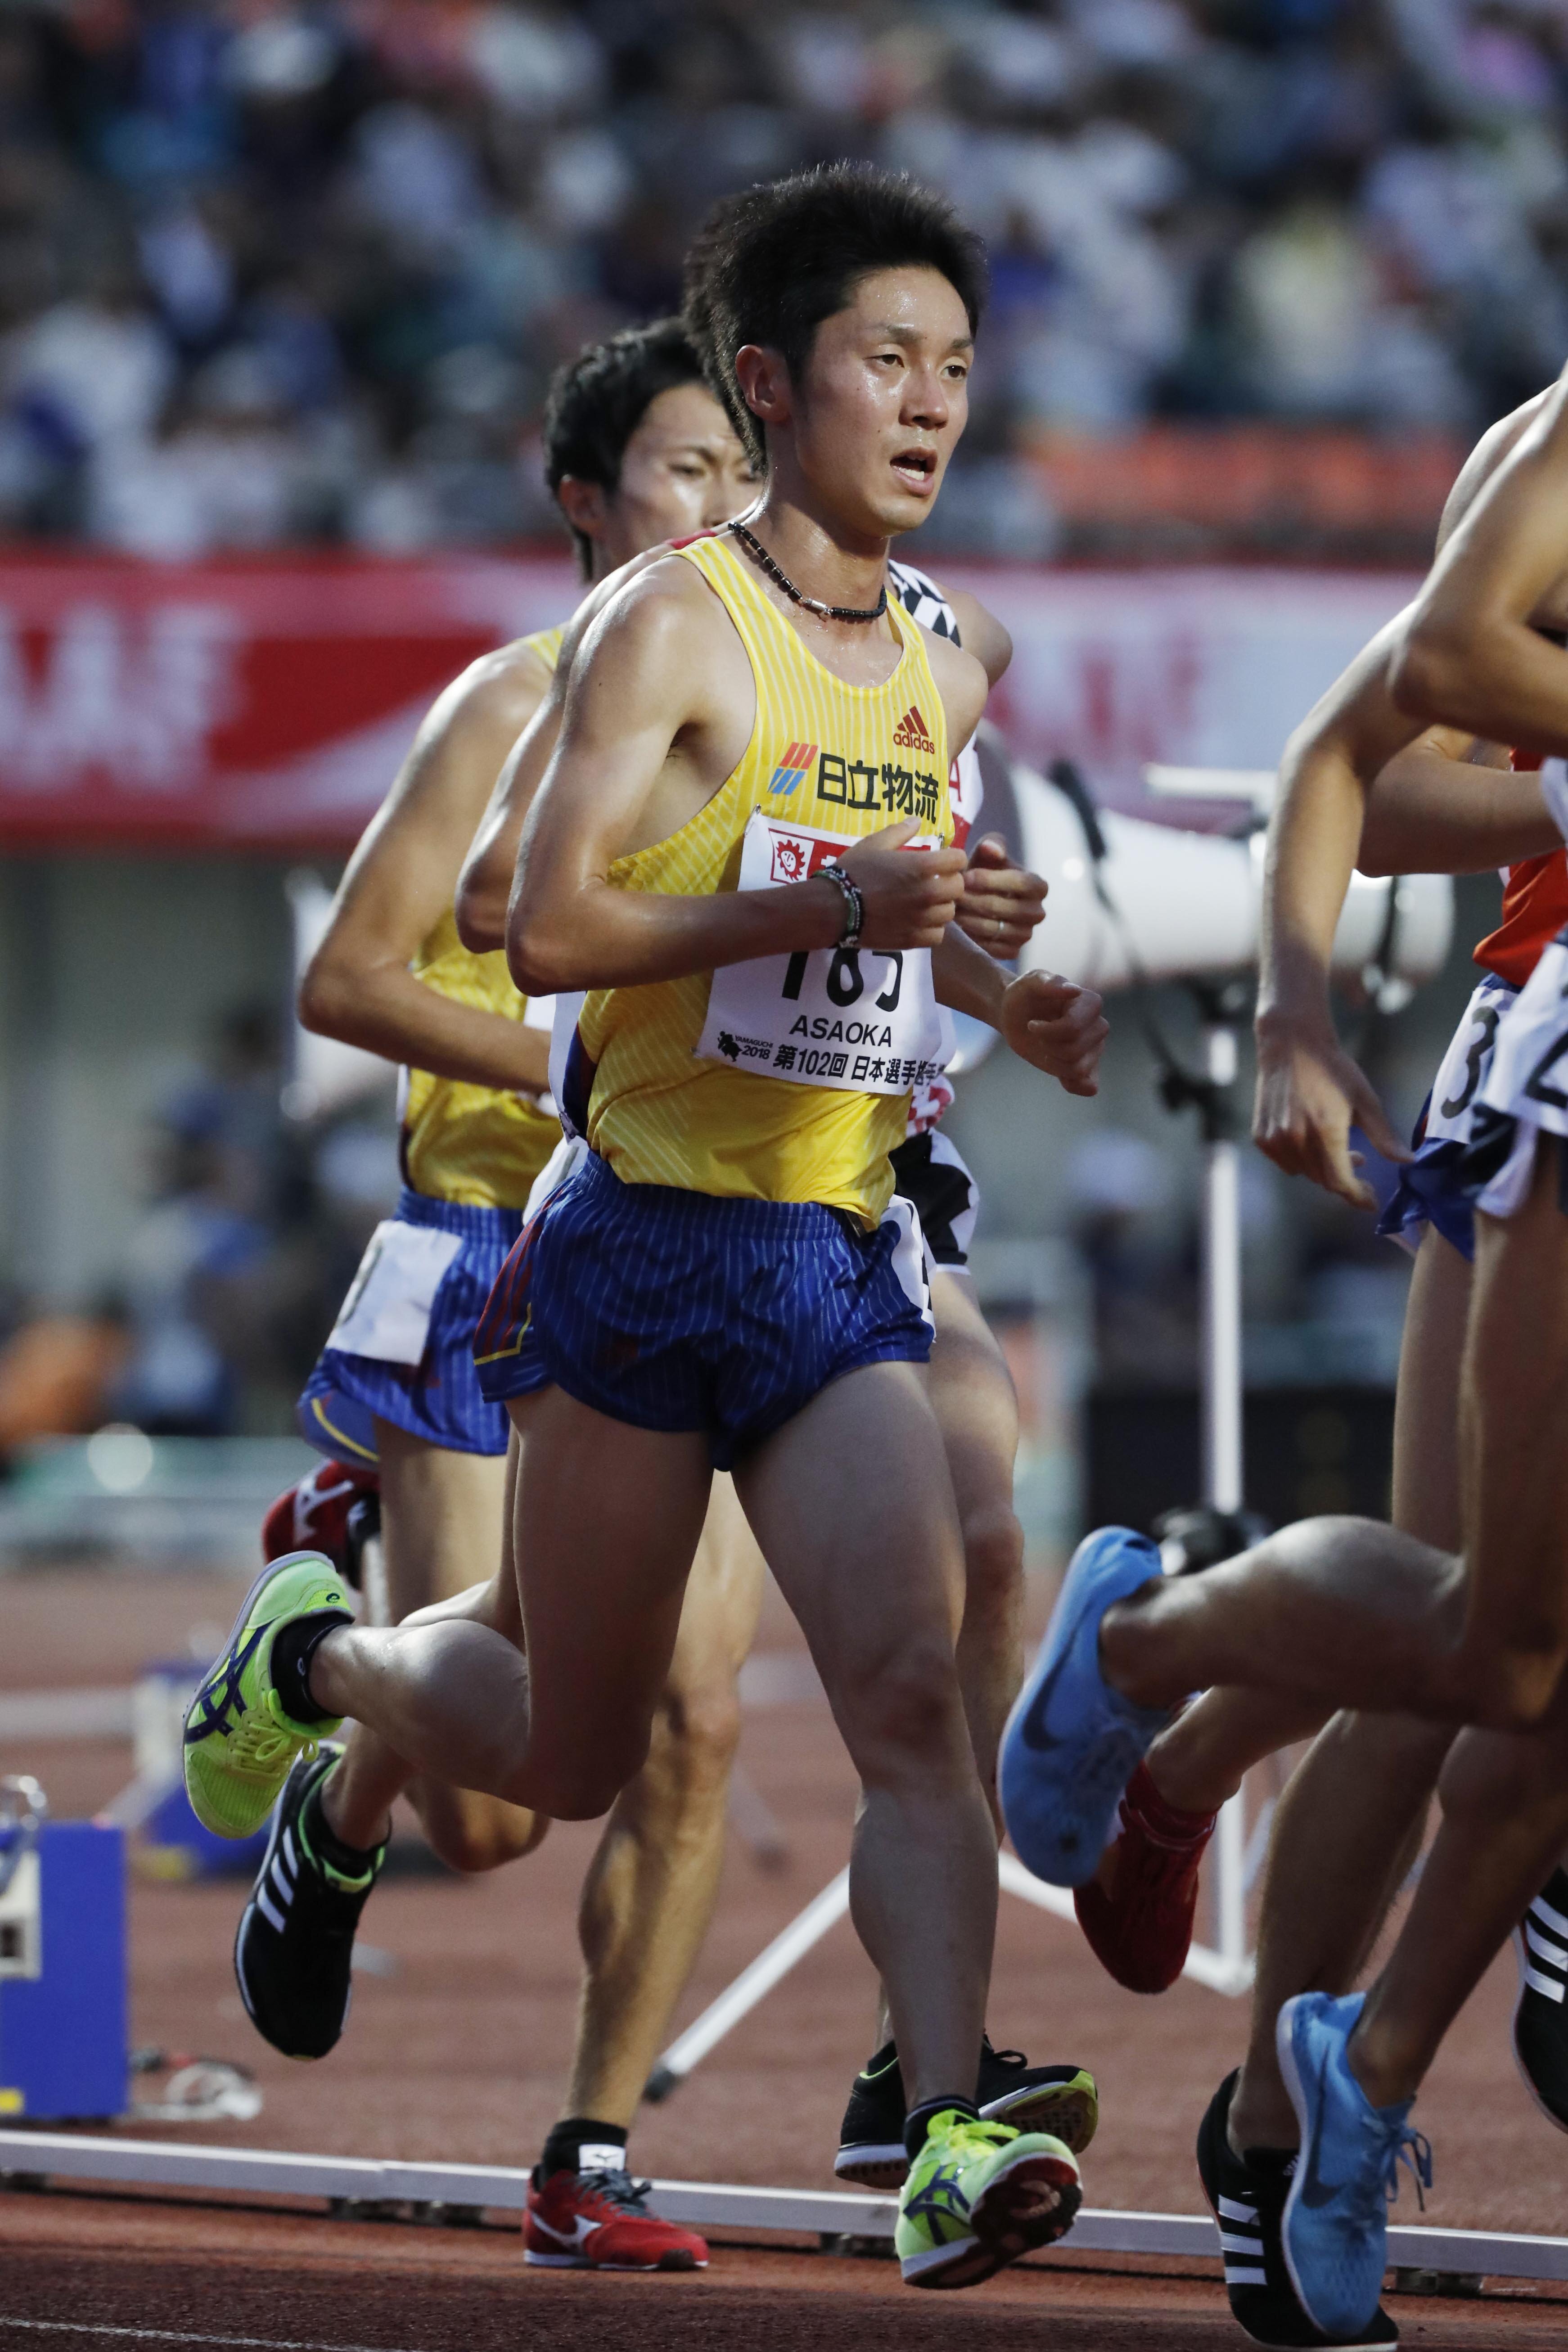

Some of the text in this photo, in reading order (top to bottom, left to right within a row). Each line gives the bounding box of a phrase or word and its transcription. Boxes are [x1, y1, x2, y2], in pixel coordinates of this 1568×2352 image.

[893, 732, 935, 754] adidas
[817, 753, 939, 825] 日立物流
[735, 1036, 774, 1048] YAMAGUCHI
[789, 1015, 891, 1047] ASAOKA
[742, 1045, 771, 1059] 2018
[773, 1044, 849, 1078] 第102回
